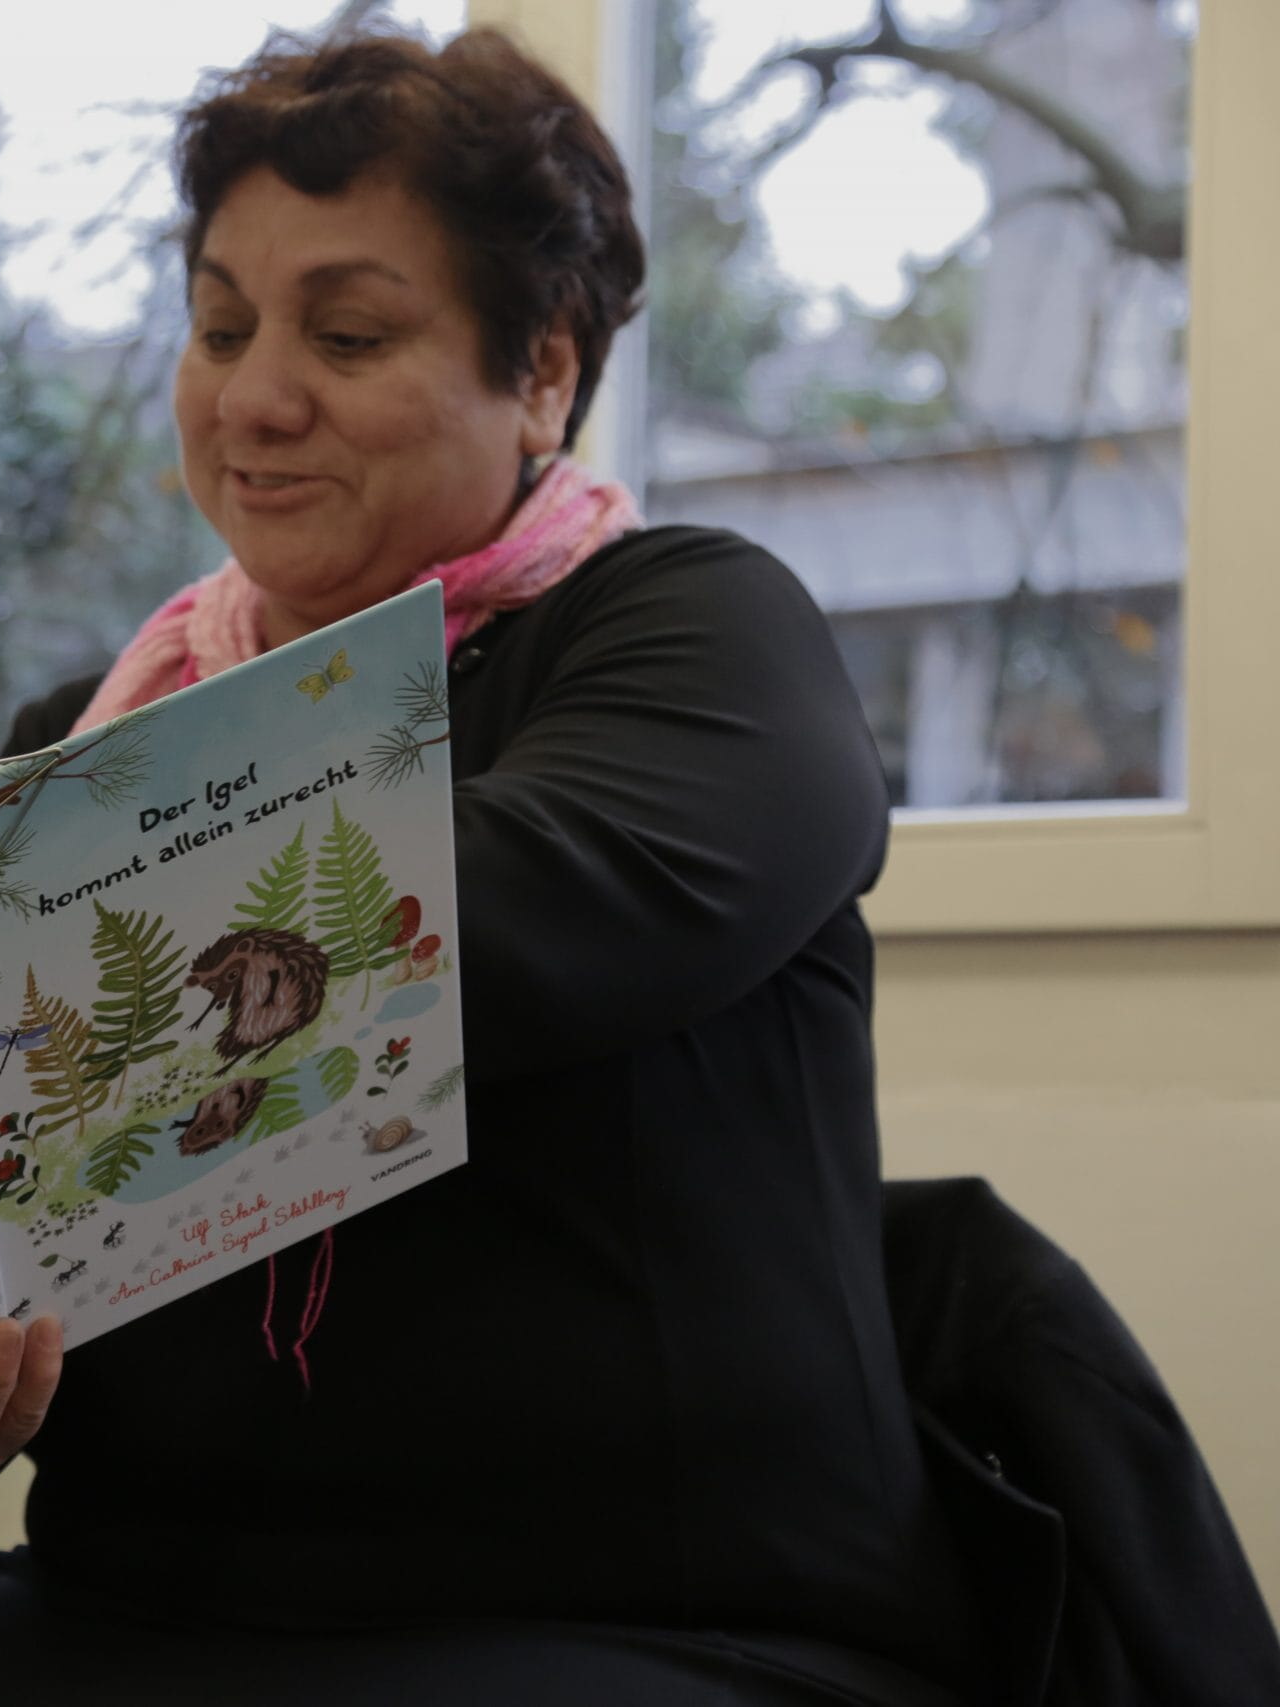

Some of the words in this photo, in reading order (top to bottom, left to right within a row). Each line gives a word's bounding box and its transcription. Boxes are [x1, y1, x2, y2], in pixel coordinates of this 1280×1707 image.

[138, 797, 196, 833] Der
[205, 762, 259, 811] Igel
[38, 854, 148, 916] kommt
[158, 820, 234, 863] allein
[243, 759, 358, 826] zurecht
[370, 1149, 433, 1182] VANDRING
[181, 1219, 211, 1246] Ulf
[220, 1193, 271, 1227] Stark
[222, 1217, 270, 1253] Sigrid
